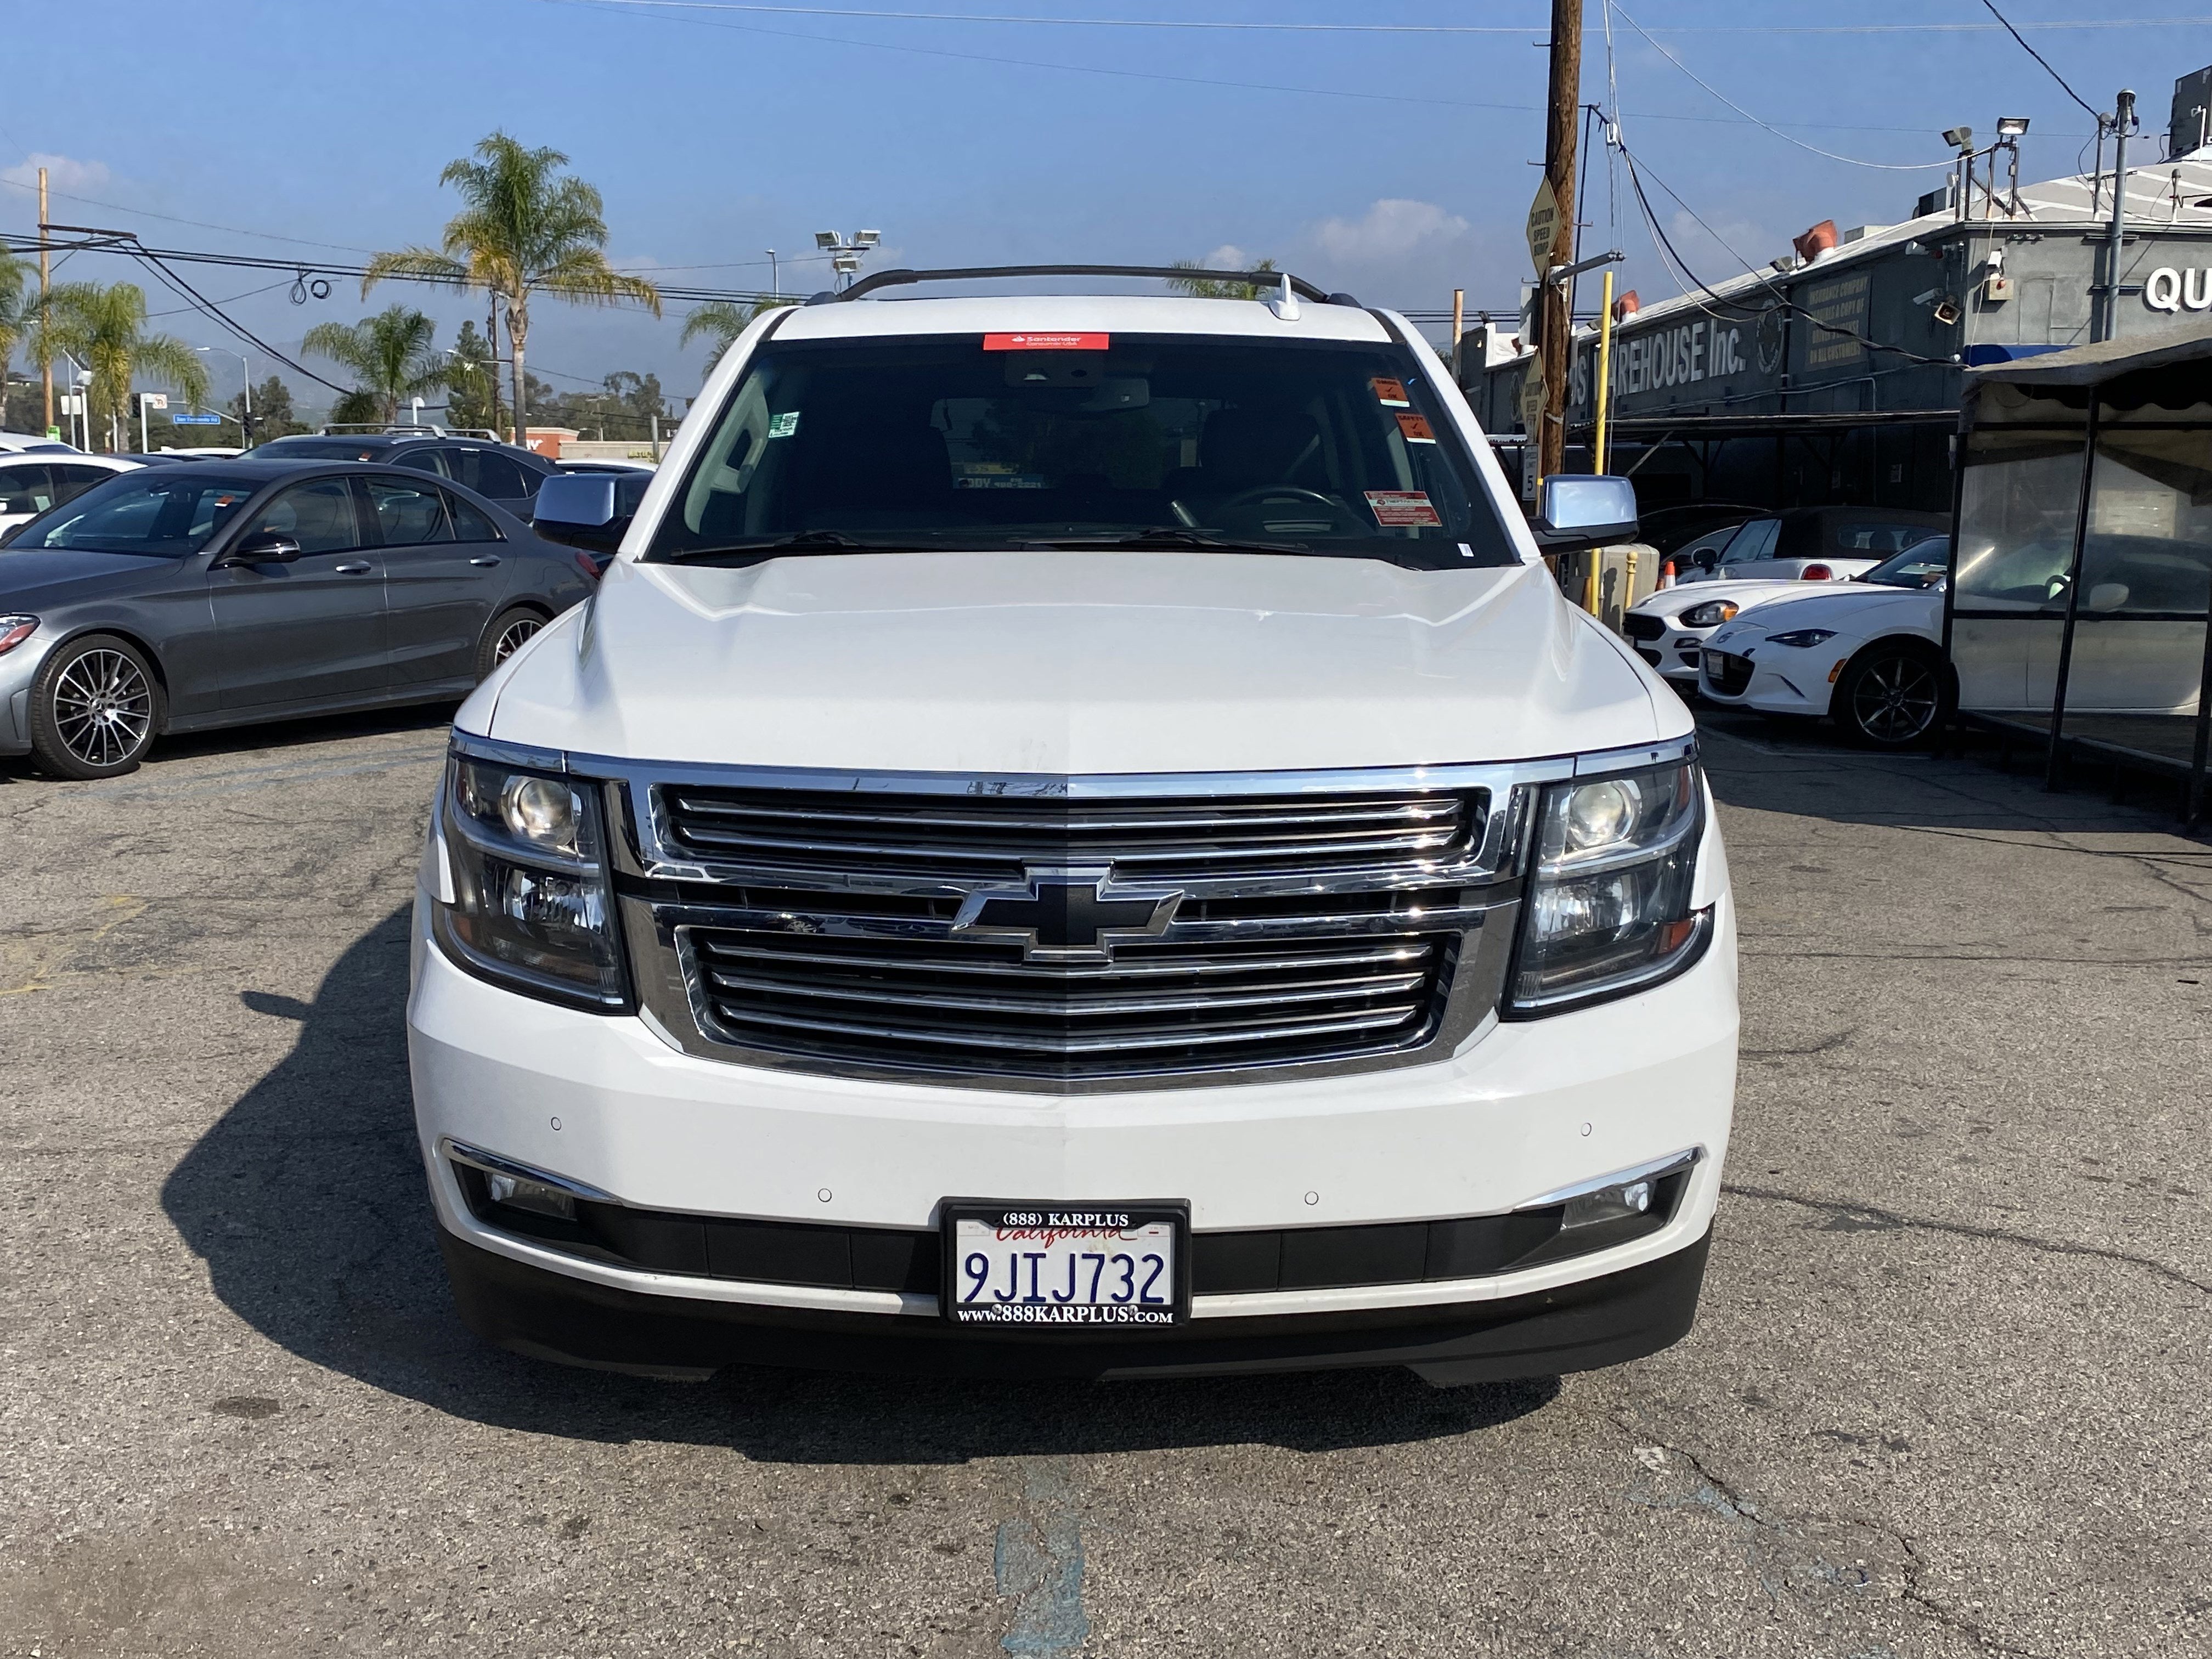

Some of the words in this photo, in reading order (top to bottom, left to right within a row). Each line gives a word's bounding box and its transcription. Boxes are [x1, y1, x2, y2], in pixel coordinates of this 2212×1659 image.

[1531, 207, 1554, 227] CAUTION
[1534, 227, 1550, 241] SPEED
[2147, 267, 2212, 312] QU
[1709, 318, 1746, 377] Inc.
[1527, 475, 1533, 492] 5
[1003, 1213, 1042, 1226] (888)
[1048, 1213, 1128, 1227] KARPLUS
[996, 1227, 1138, 1249] California
[964, 1252, 1164, 1303] 9JIJ732
